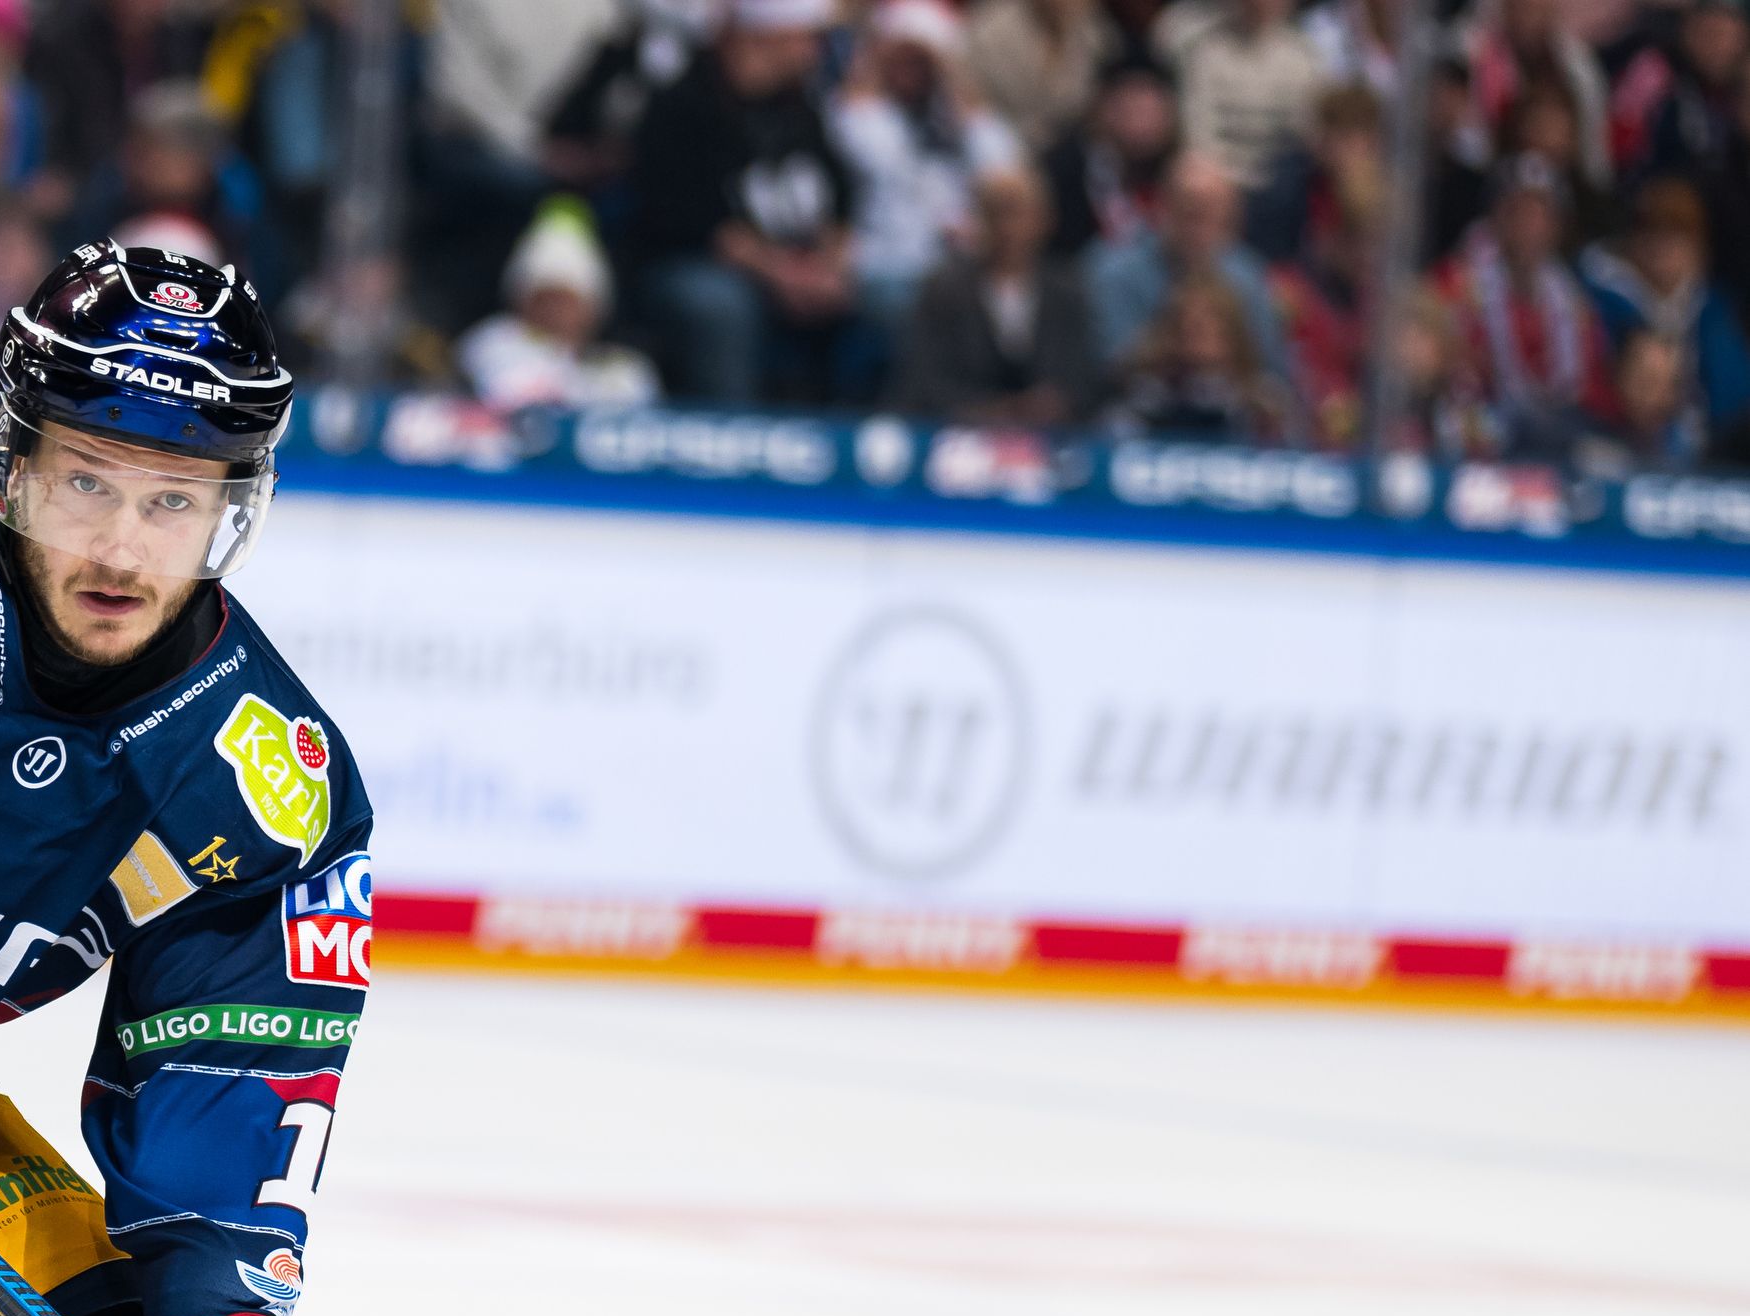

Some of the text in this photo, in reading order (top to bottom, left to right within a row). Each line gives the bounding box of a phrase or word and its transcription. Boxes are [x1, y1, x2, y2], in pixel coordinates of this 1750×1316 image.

[90, 357, 231, 404] STADLER
[119, 656, 240, 744] flash-security
[233, 714, 325, 847] Karls
[260, 792, 281, 820] 1921
[141, 1013, 210, 1045] LIGO
[221, 1011, 292, 1037] LIGO
